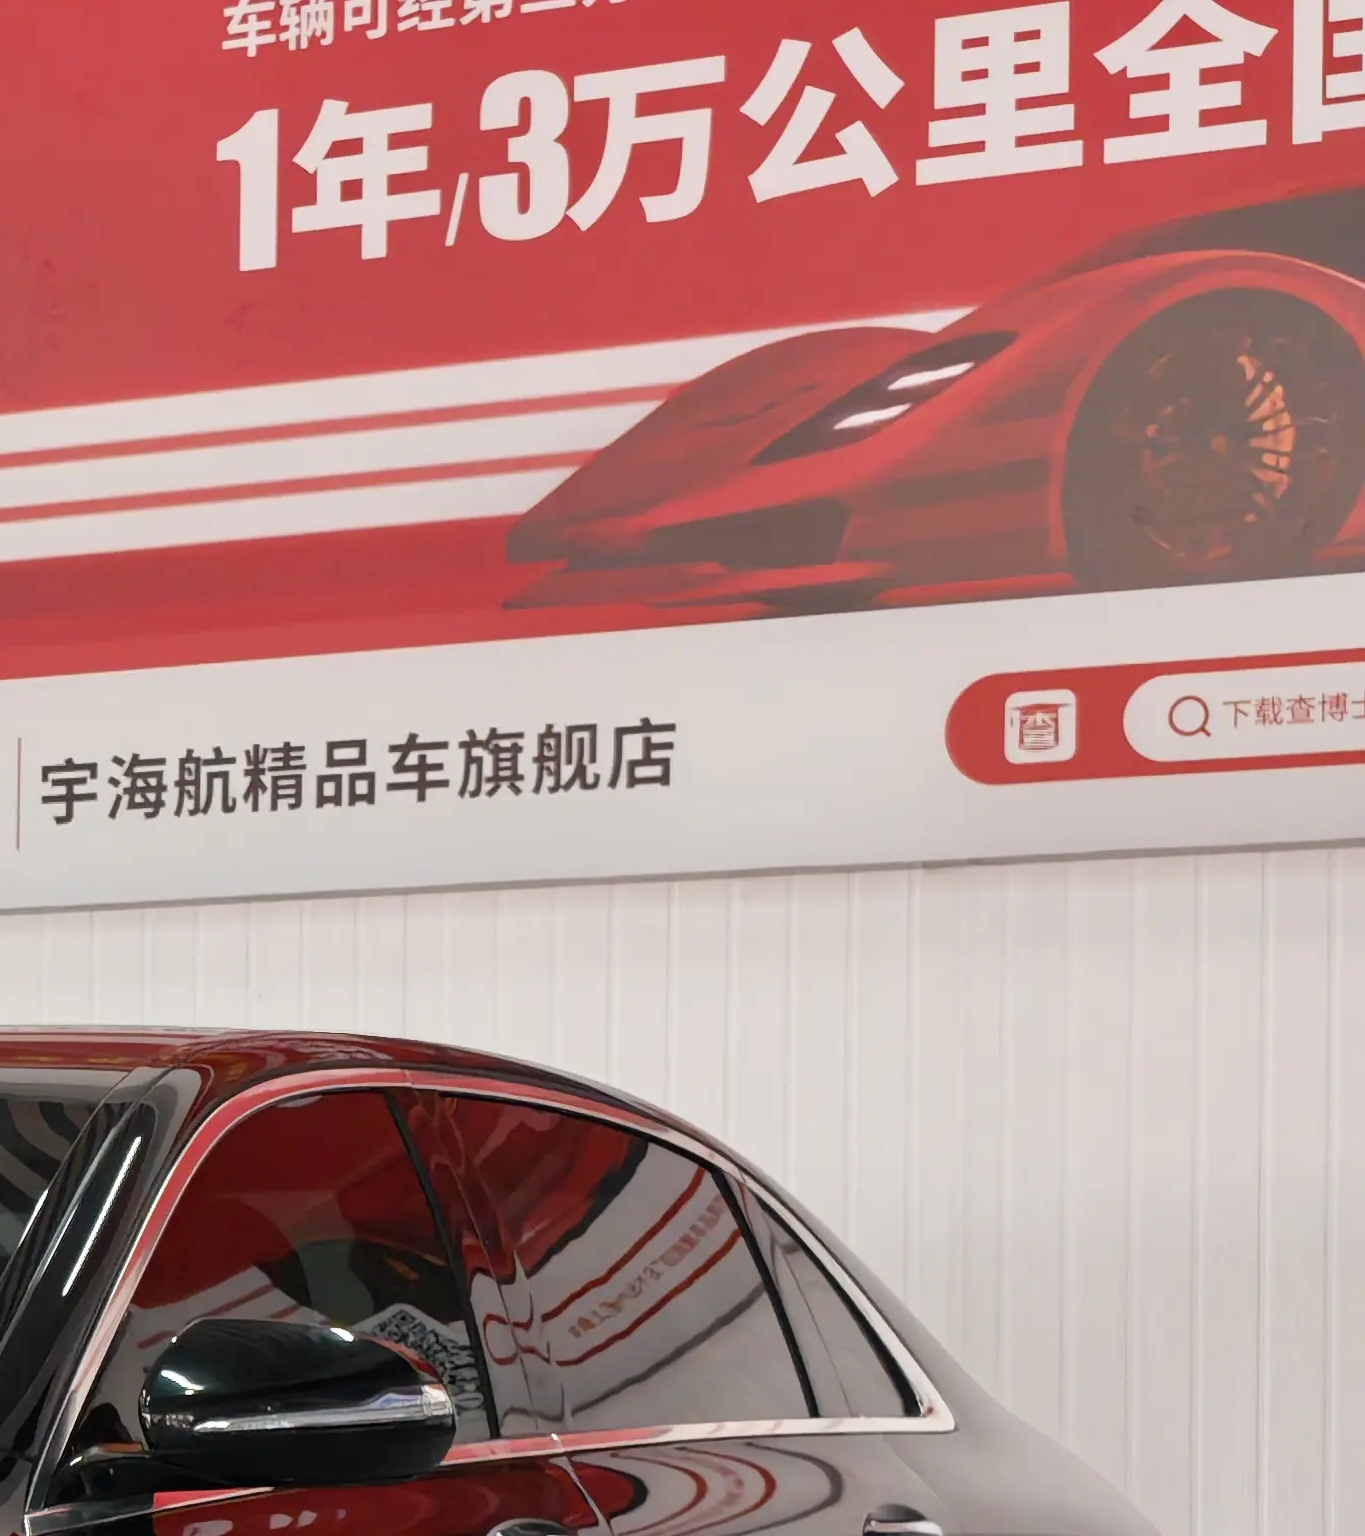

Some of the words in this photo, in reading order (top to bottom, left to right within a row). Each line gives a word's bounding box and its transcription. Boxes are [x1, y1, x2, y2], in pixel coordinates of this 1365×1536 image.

[221, 0, 627, 57] 车辆可经
[40, 717, 677, 826] 宇海航精品车旗舰店
